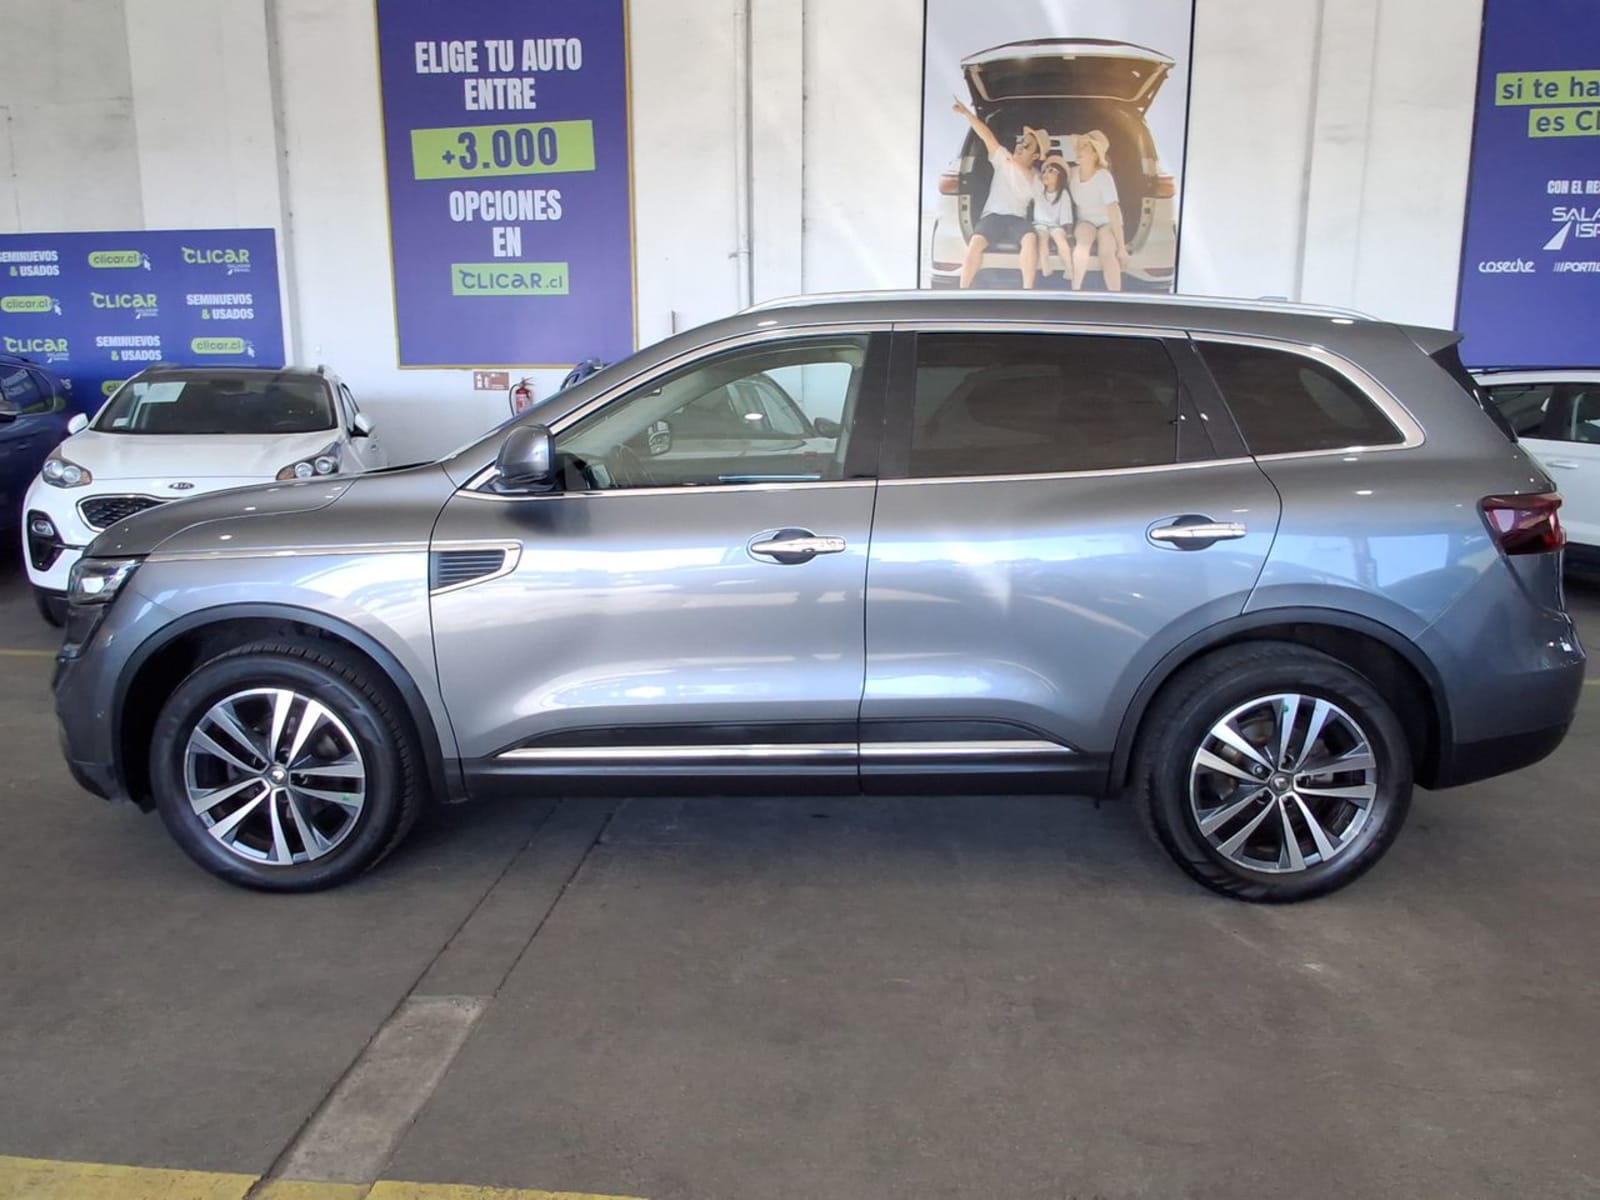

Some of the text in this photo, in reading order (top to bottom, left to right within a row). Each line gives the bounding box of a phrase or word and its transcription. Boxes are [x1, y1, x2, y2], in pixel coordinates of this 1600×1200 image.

[415, 38, 583, 74] ELIGE TU AUTO
[464, 77, 537, 110] ENTRE
[1502, 76, 1600, 99] si te ha
[1536, 116, 1565, 132] es
[441, 127, 558, 170] +3.000
[1547, 180, 1570, 195] CON
[1571, 180, 1584, 195] EL
[449, 189, 562, 222] OPCIONES
[492, 226, 522, 257] EN
[93, 254, 137, 264] clicar.cl
[10, 265, 60, 276] & USADOS
[6, 298, 48, 309] clicar.cl
[186, 293, 253, 305] SEMINUEVOS
[202, 308, 254, 320] & USADOS
[96, 335, 161, 347] SEMINUEVOS
[196, 340, 241, 350] clicar.cl
[111, 350, 162, 361] & USADOS
